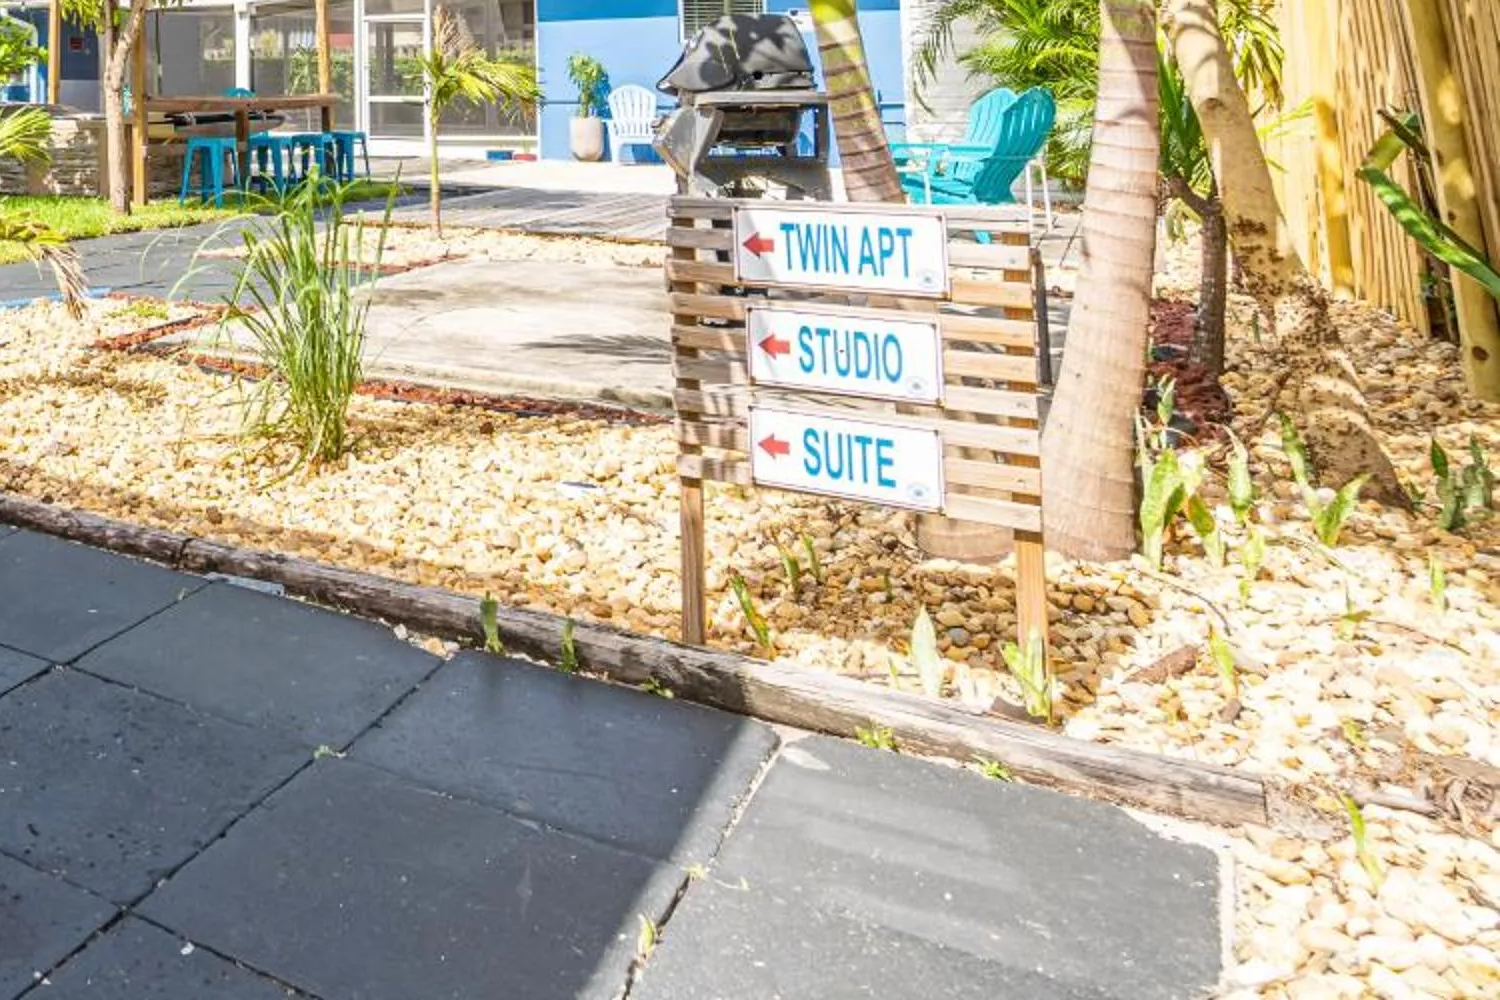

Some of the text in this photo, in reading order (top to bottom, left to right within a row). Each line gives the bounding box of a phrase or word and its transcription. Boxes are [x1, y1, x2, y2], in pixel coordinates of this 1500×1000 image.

[780, 222, 913, 278] TWIN APT
[798, 325, 903, 383] STUDIO
[803, 427, 897, 488] SUITE
